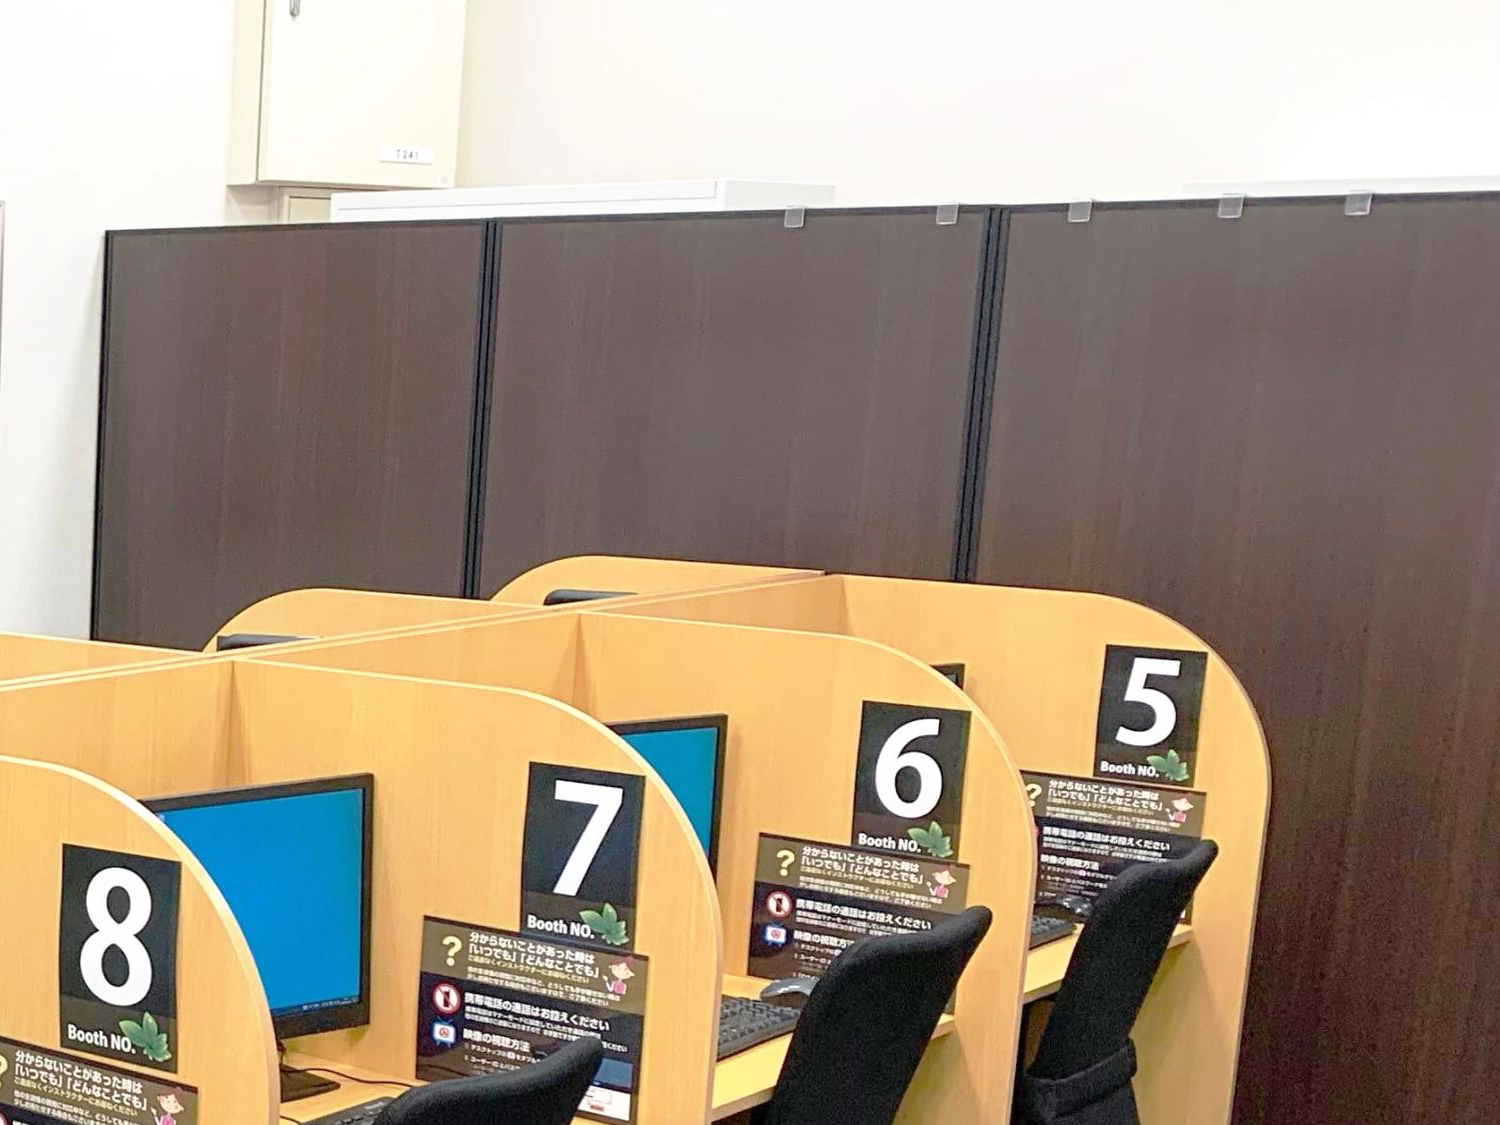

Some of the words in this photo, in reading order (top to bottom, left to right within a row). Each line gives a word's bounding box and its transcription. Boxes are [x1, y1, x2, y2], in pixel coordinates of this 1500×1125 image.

[1115, 657, 1181, 747] 5
[875, 718, 943, 819] 6
[1100, 761, 1135, 776] Booth
[1137, 765, 1160, 779] NO.
[553, 780, 623, 896] 7
[858, 833, 896, 851] Booth
[898, 838, 922, 854] NO.
[79, 866, 153, 1007] 8
[527, 914, 567, 935] Booth
[569, 922, 595, 939] NO.
[469, 931, 595, 964] 分からないことがあった時は
[67, 1023, 108, 1049] Booth
[110, 1034, 137, 1055] NO.
[15, 1050, 143, 1094] 分からないことがあった時は
